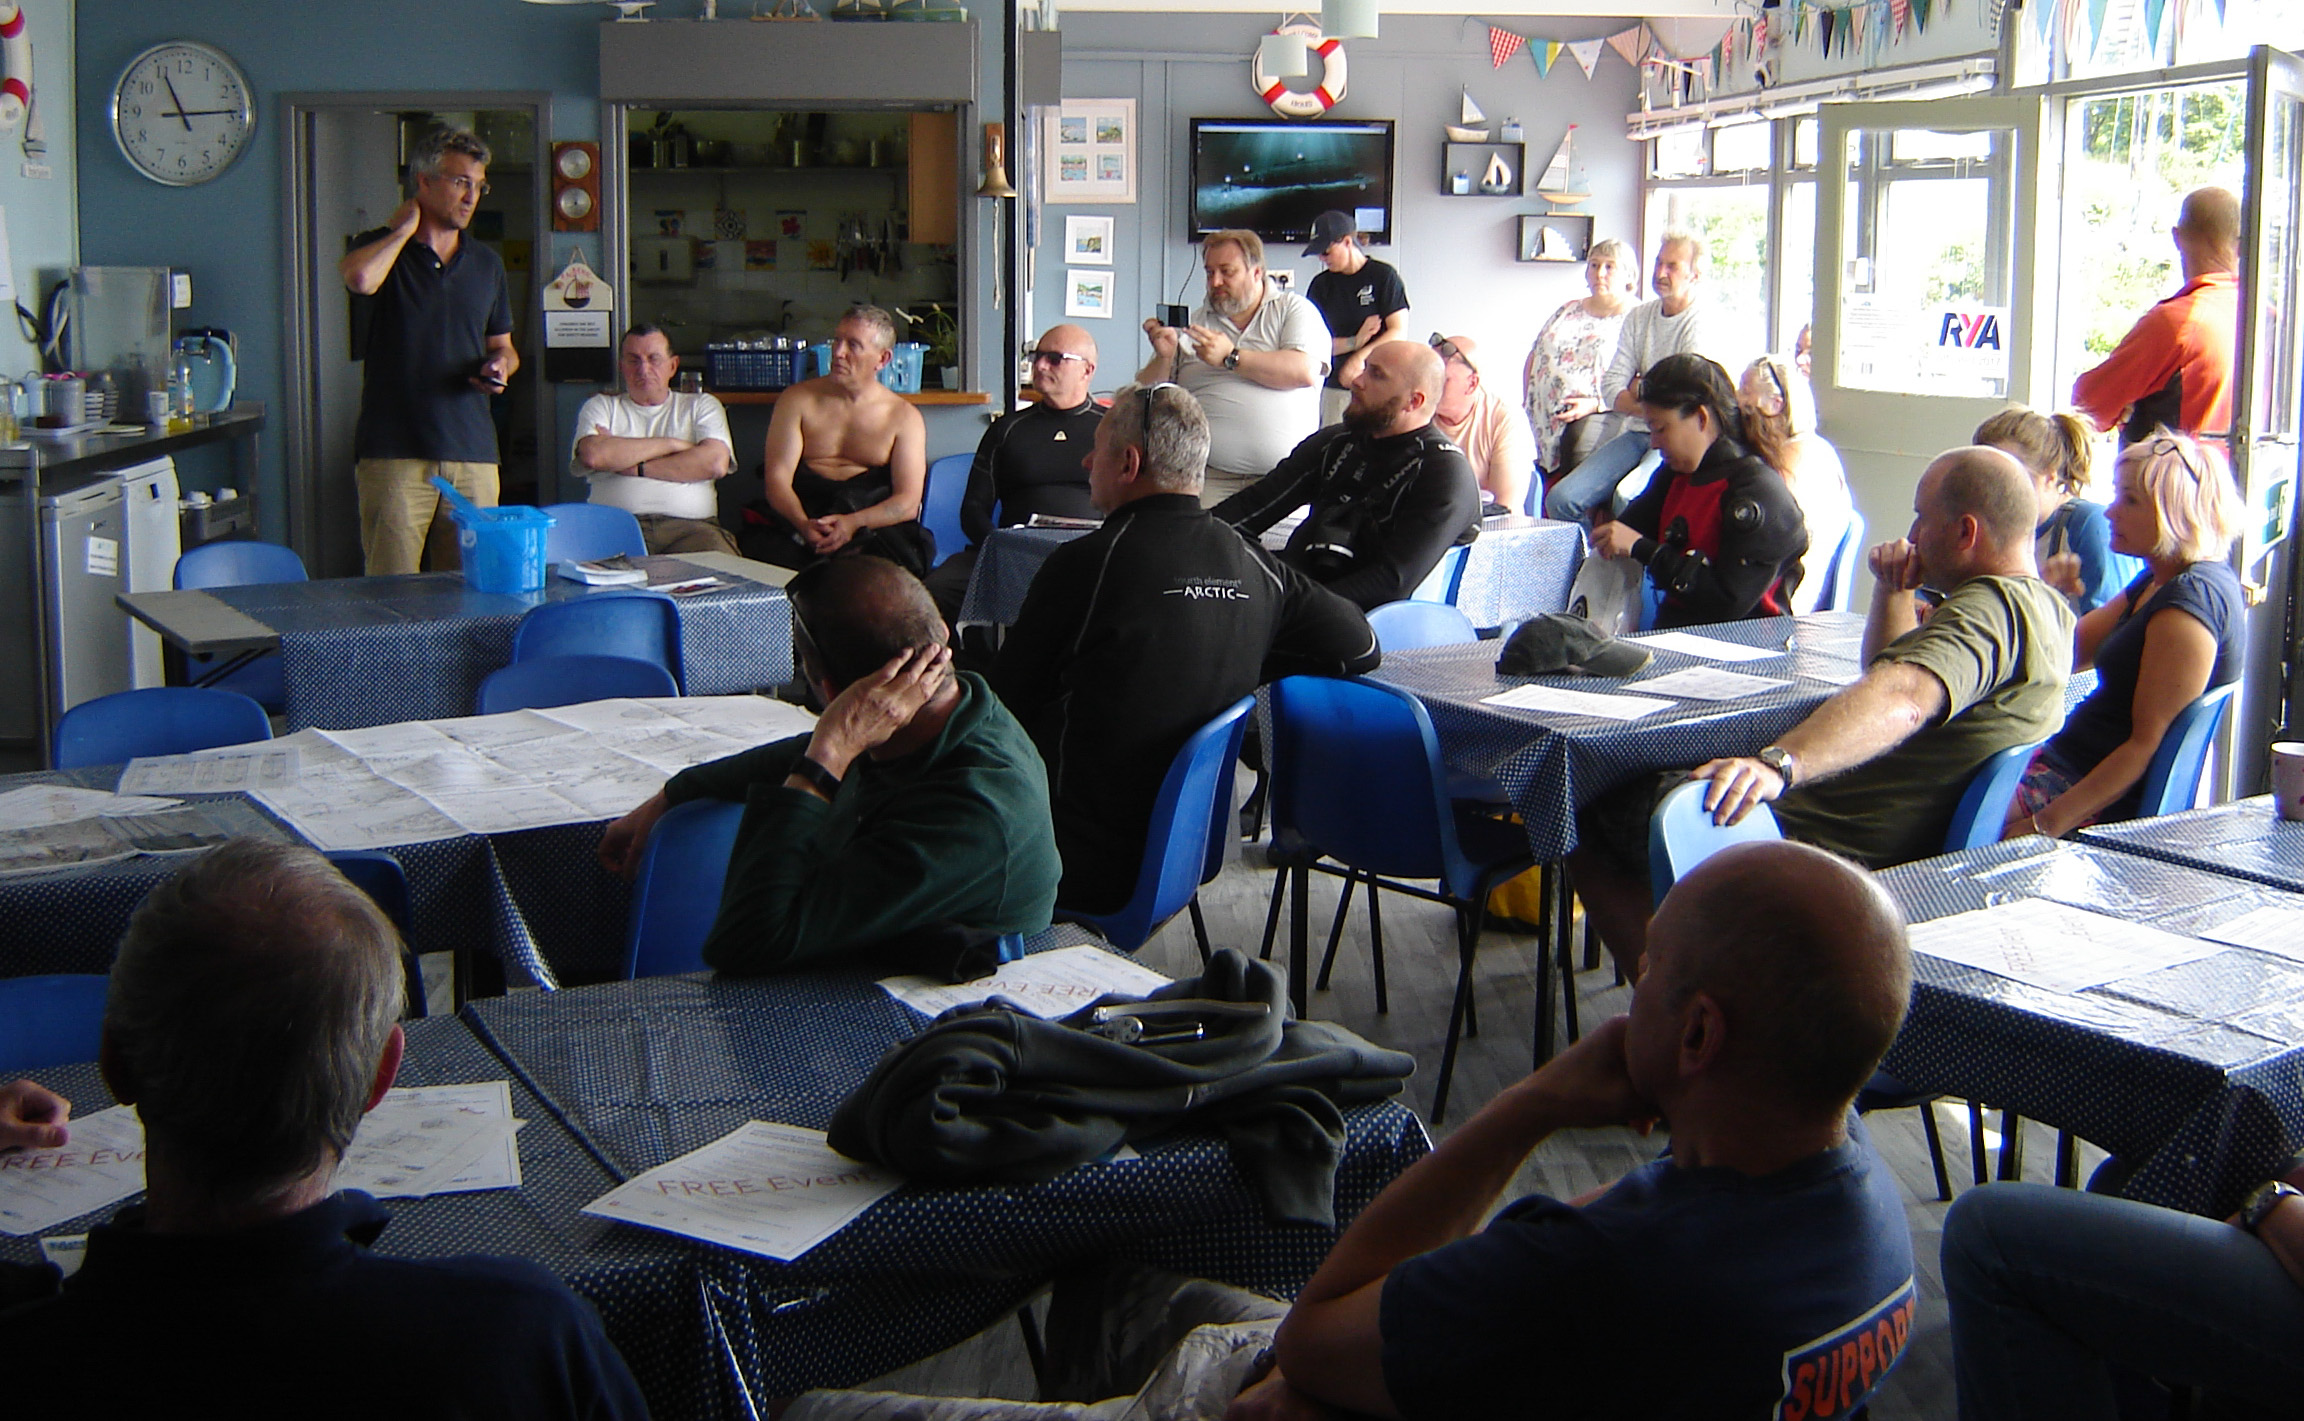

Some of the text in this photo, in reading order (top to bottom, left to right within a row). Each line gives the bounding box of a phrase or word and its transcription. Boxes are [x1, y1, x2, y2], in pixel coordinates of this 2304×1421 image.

[178, 60, 193, 74] 12
[205, 67, 210, 82] 1
[140, 81, 153, 95] 10
[220, 86, 228, 99] 2
[132, 106, 141, 118] 9
[139, 129, 147, 142] 8
[217, 133, 226, 146] 4
[157, 148, 165, 161] 7
[202, 151, 210, 164] 5
[178, 155, 187, 168] 6
[1939, 313, 2000, 350] RYA
[1184, 586, 1236, 600] ARCTIC
[0, 1152, 82, 1171] REE
[657, 1179, 761, 1197] FREE
